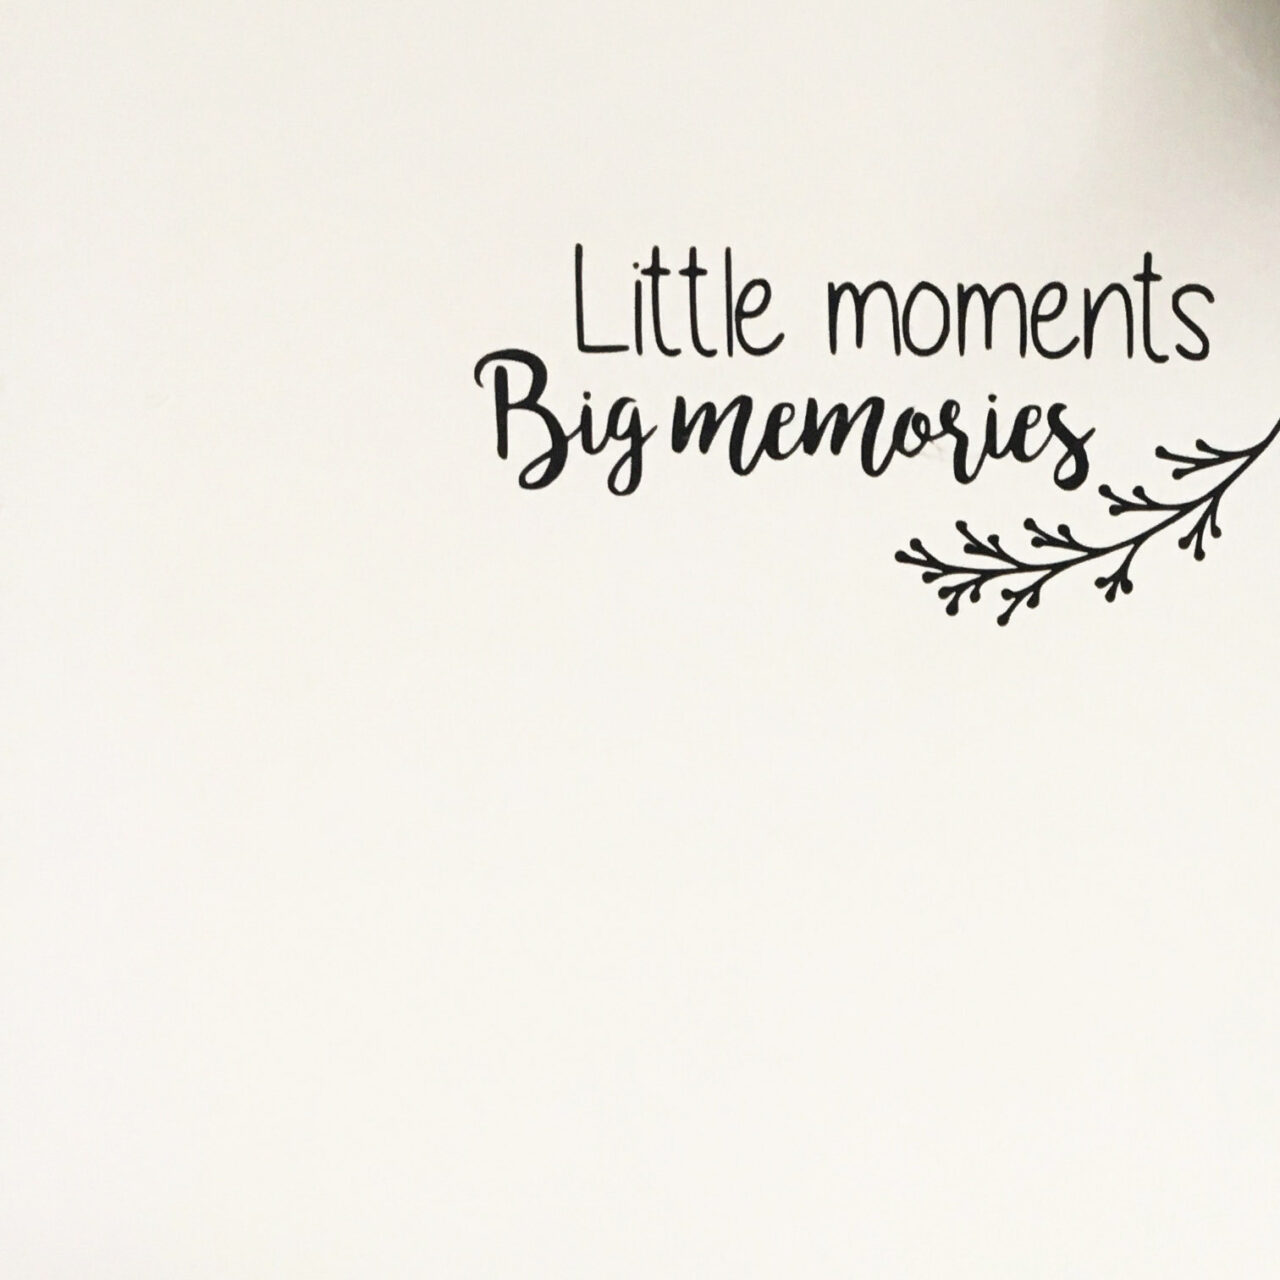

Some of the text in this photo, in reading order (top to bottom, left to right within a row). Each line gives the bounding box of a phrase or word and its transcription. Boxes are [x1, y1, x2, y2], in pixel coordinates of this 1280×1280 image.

[574, 243, 1215, 363] Little moments
[474, 348, 1096, 497] Big memories
